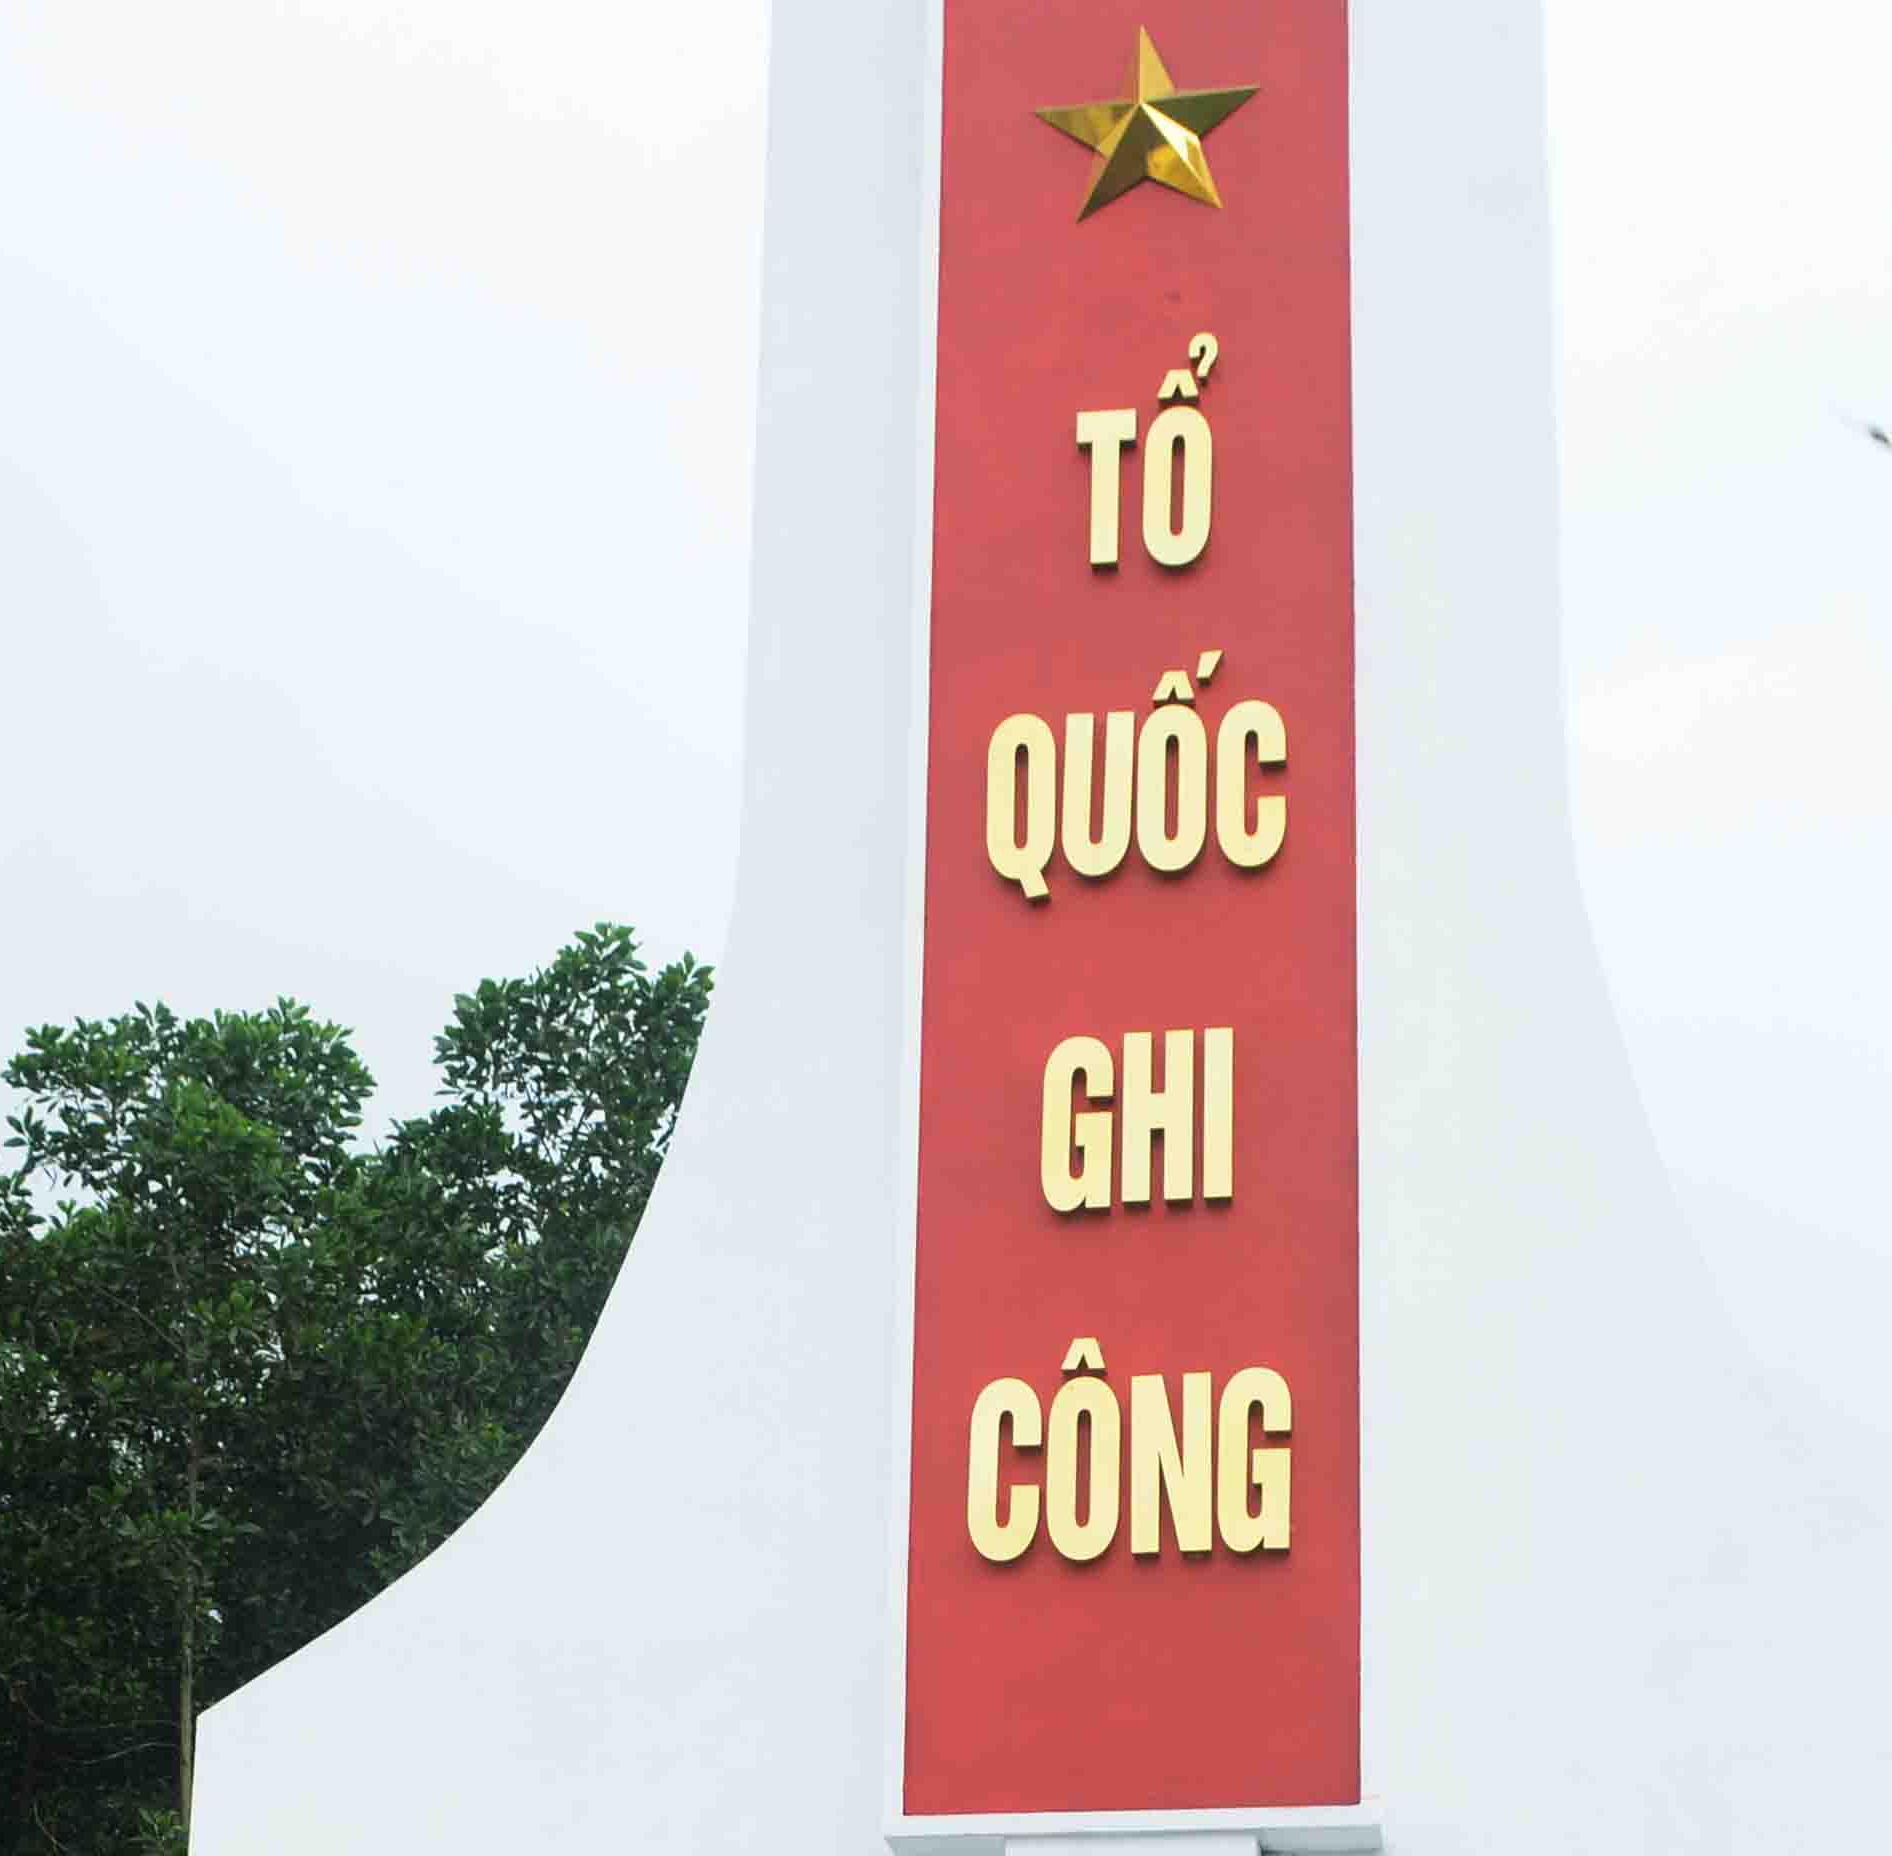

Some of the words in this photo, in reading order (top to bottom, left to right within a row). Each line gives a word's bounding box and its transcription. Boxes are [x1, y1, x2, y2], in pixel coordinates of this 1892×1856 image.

[1076, 332, 1218, 567] TỔ
[985, 650, 1288, 899] QUỐC
[1040, 1026, 1234, 1213] GHI
[966, 1337, 1293, 1562] CÔNG
